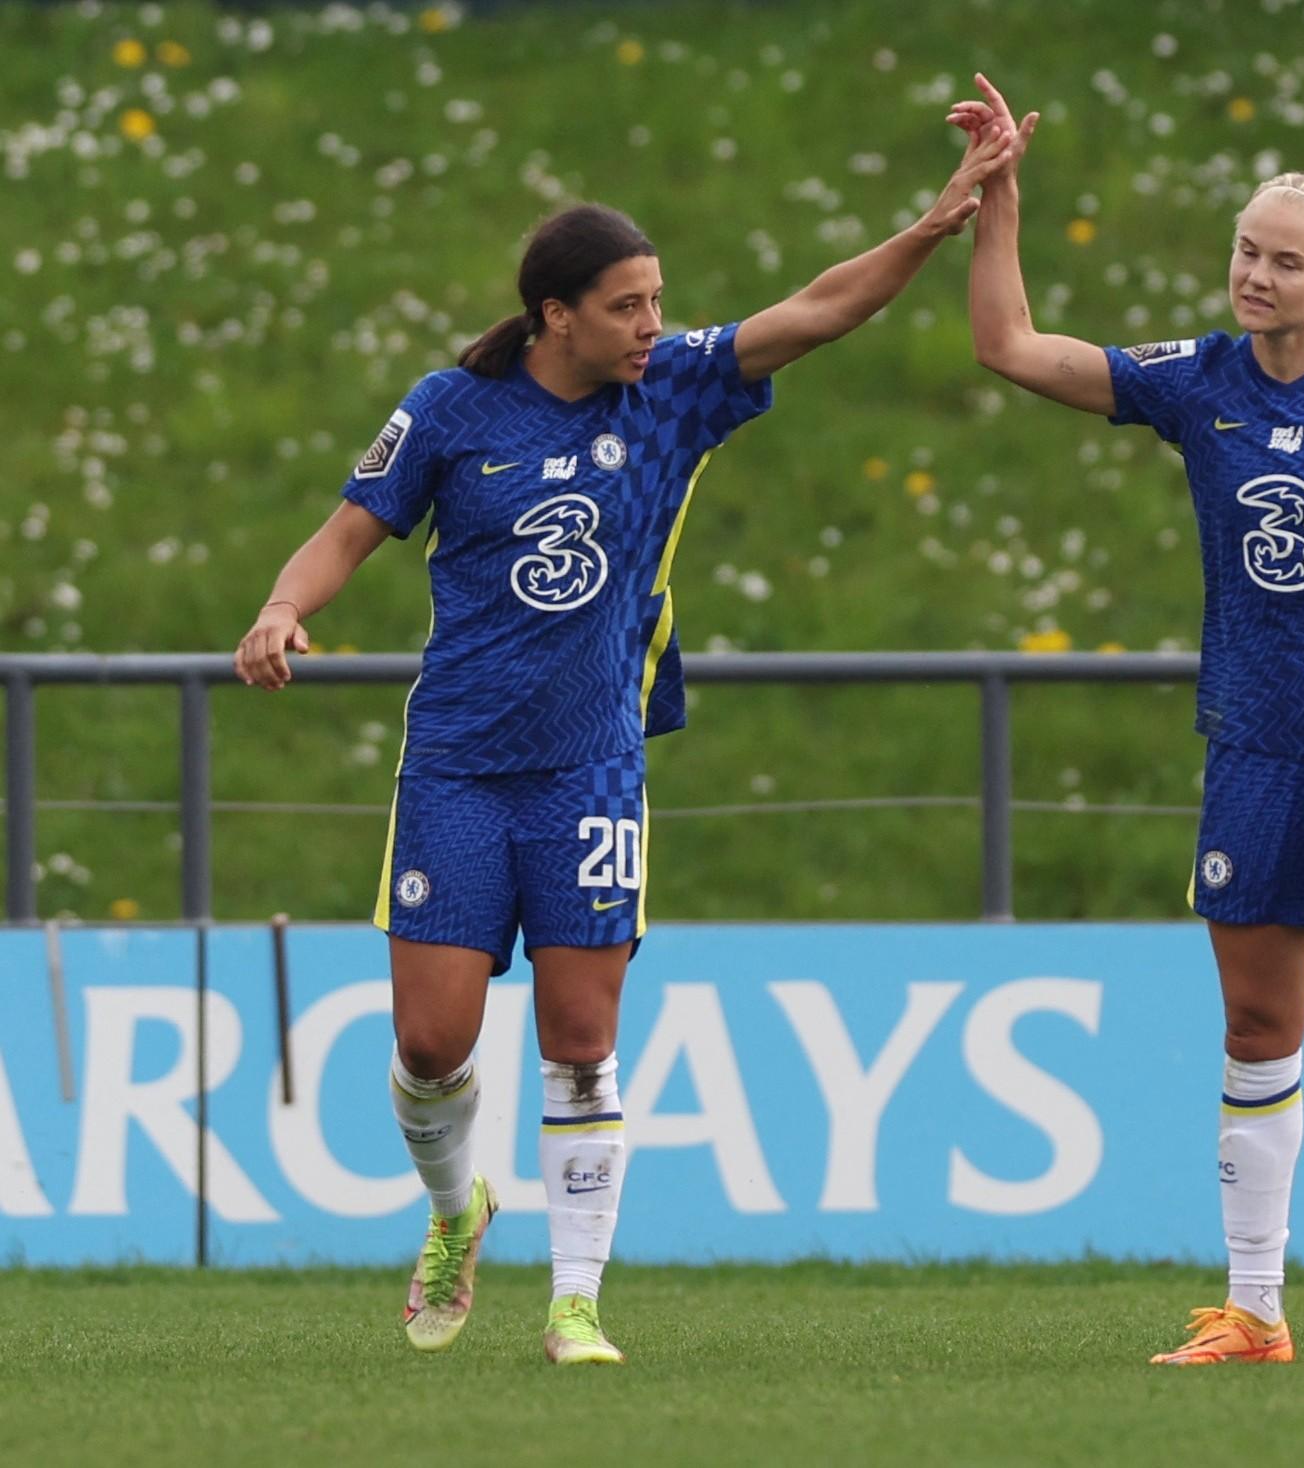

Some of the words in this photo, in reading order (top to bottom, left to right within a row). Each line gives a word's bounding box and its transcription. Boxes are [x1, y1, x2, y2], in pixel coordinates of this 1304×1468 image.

[511, 494, 608, 612] 3
[578, 816, 641, 889] 20
[567, 1171, 610, 1183] CFC
